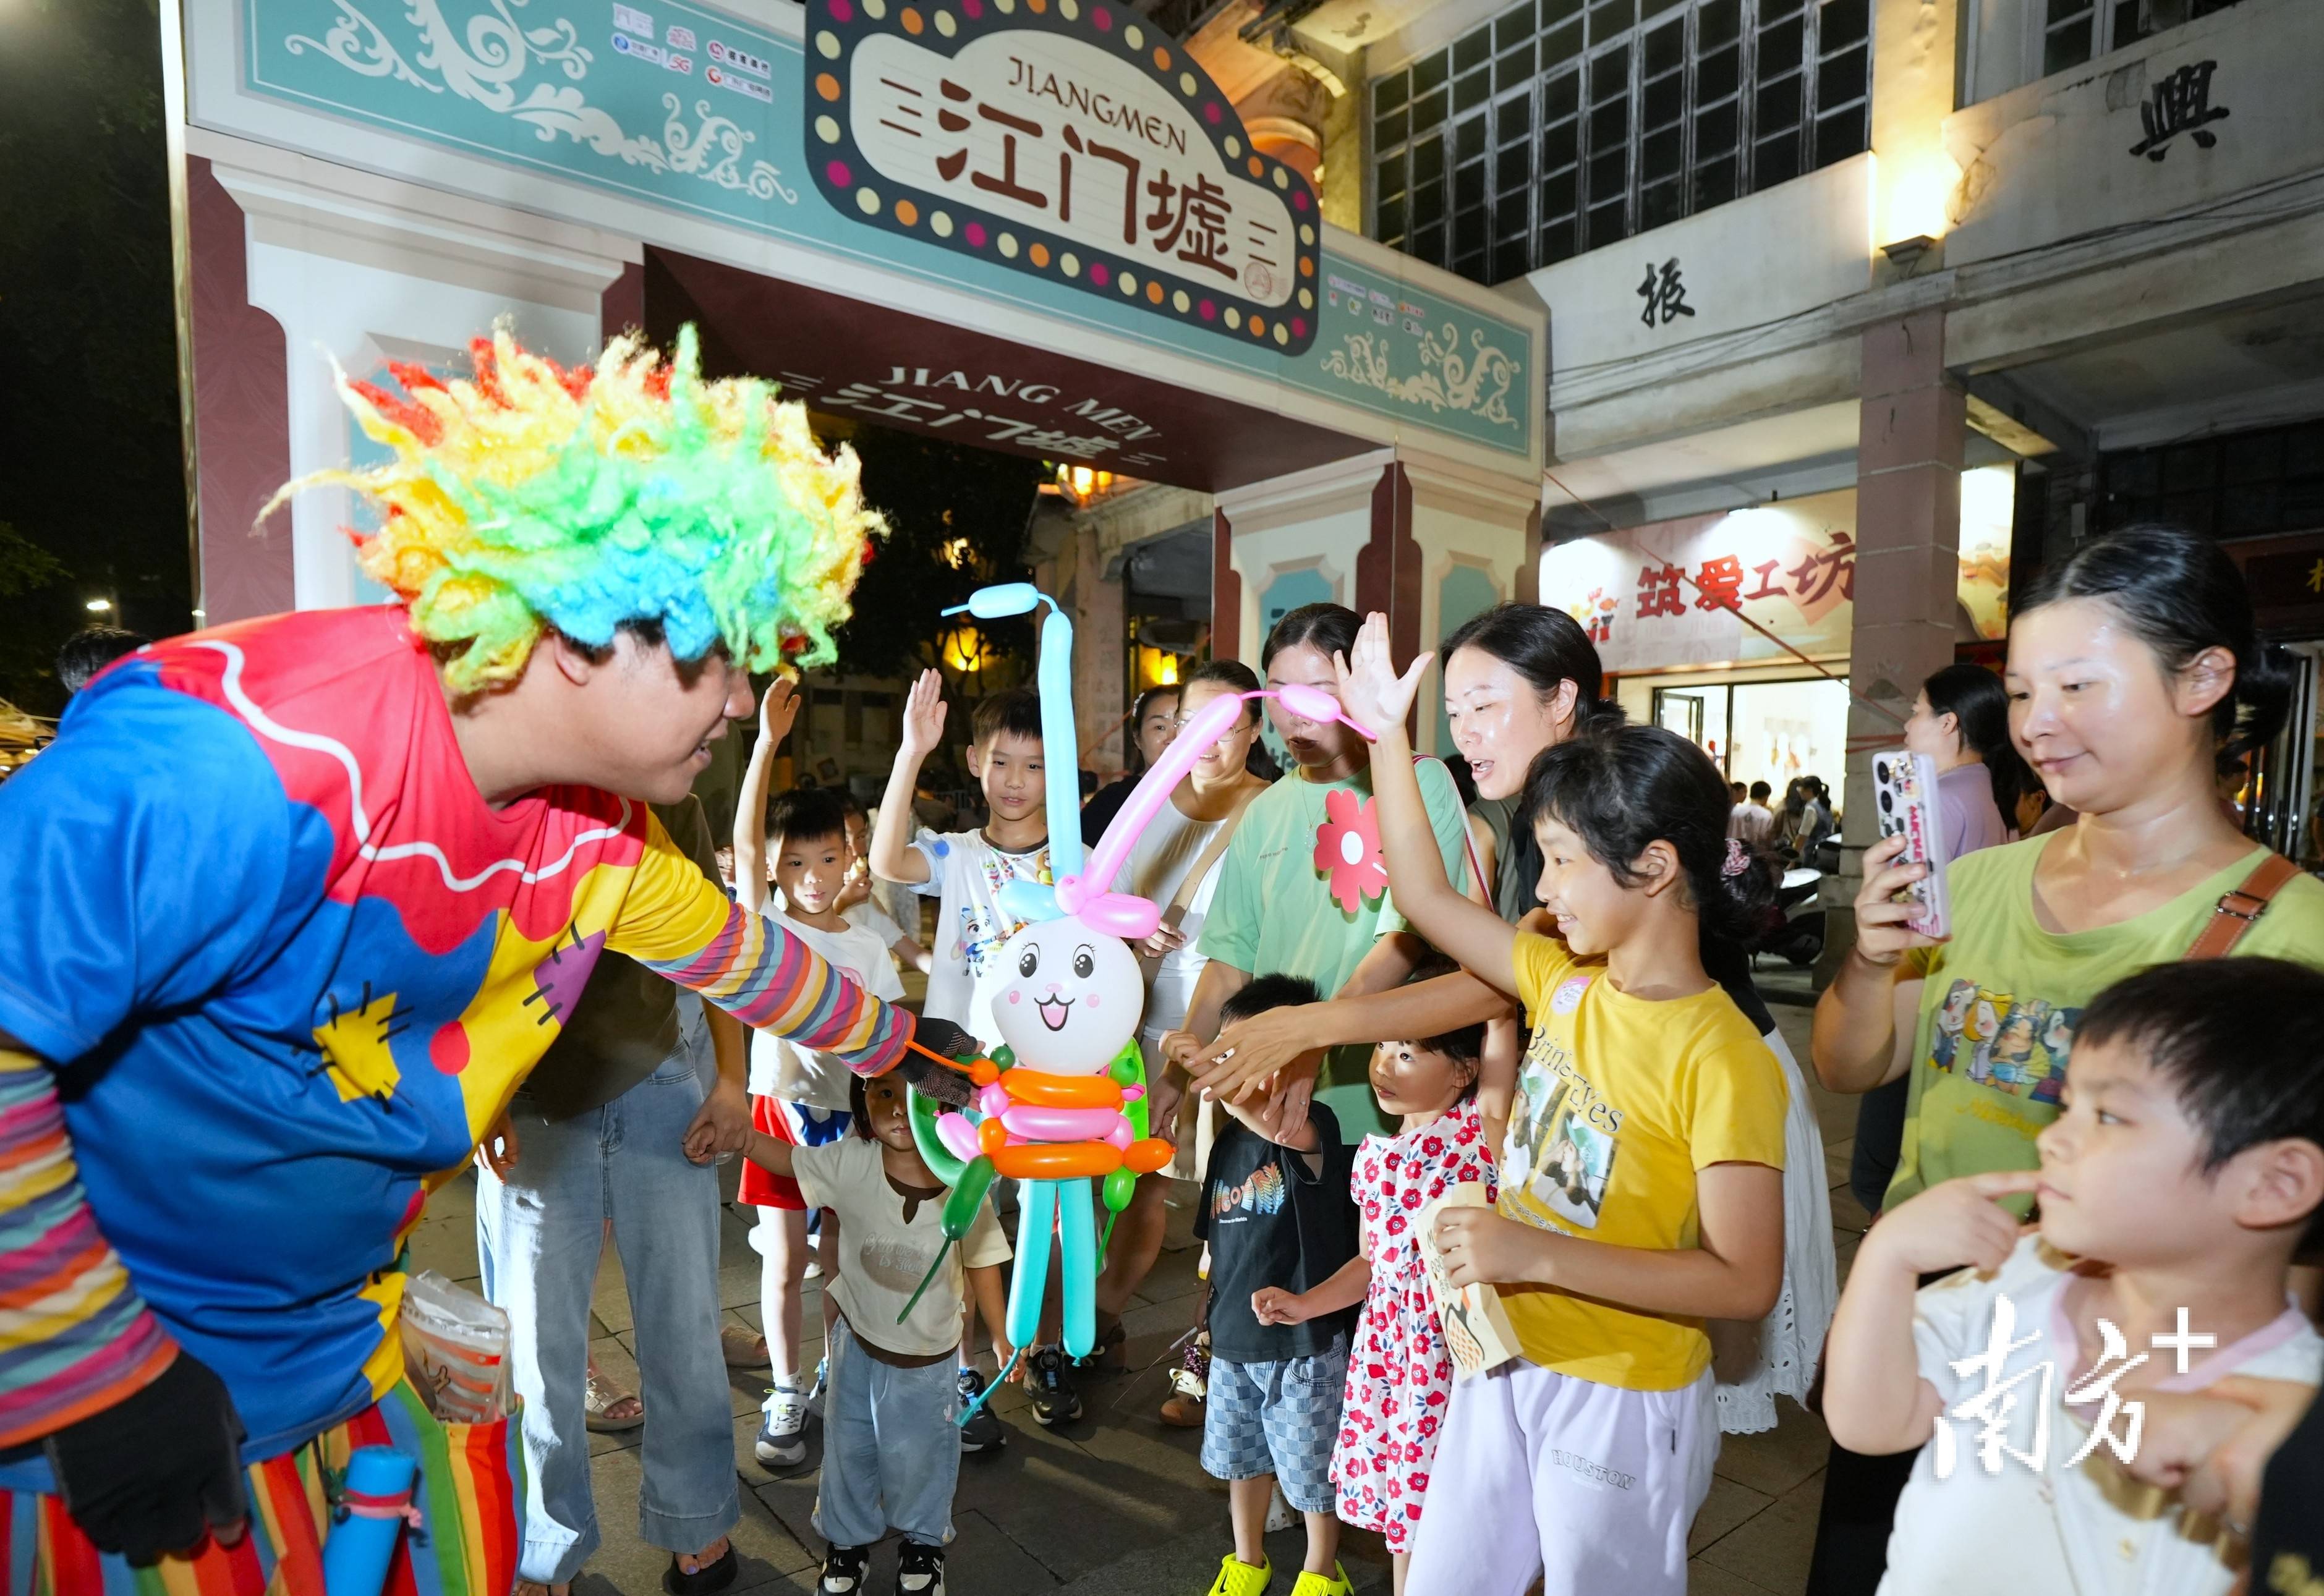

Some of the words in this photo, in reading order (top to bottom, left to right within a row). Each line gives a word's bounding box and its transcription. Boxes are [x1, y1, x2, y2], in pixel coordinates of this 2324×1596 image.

[1008, 56, 1186, 156] JIANGMEN
[935, 77, 1238, 281] 江门墟
[1636, 257, 1696, 329] 振
[820, 382, 1120, 460] 江门墟
[878, 366, 1061, 404] JIANG
[1062, 397, 1162, 441] MEN
[1635, 531, 1857, 620] 筑爱工坊
[1908, 804, 1925, 864] MICKE
[1551, 1449, 1637, 1491] HOUSTON
